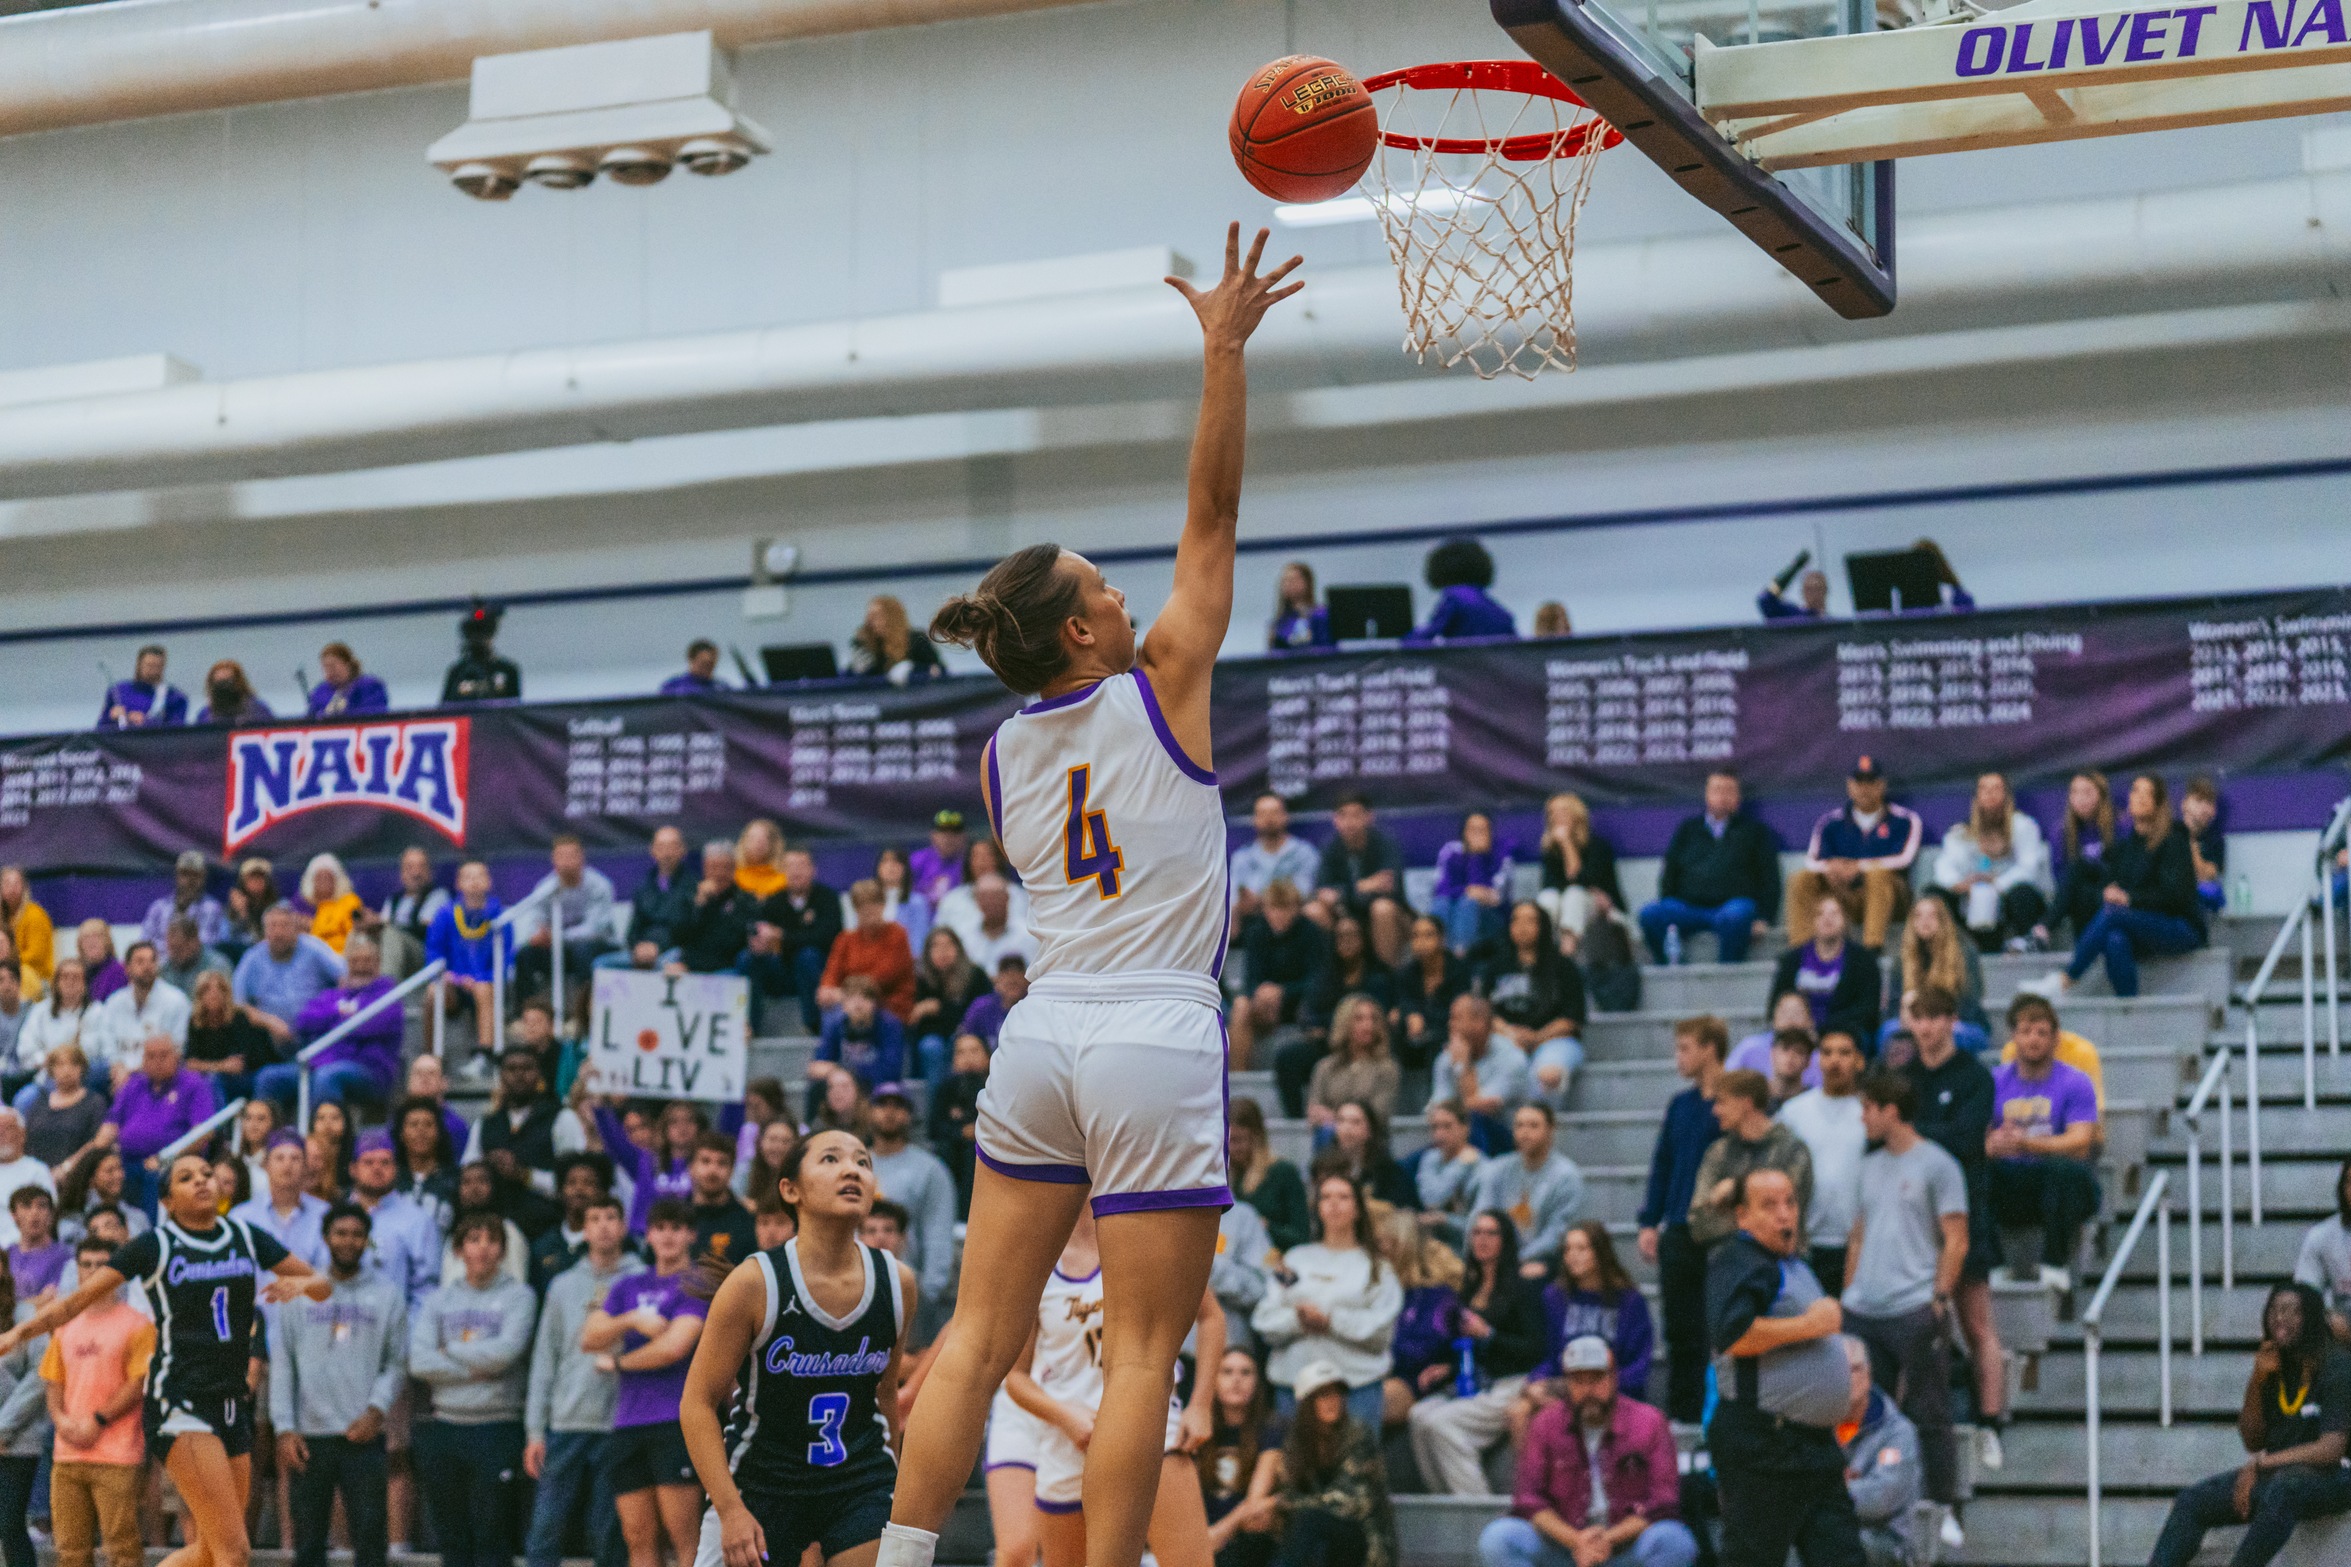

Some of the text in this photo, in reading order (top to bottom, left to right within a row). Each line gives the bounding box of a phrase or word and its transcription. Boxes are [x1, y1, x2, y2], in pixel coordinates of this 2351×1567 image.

[1955, 0, 2351, 77] OLIVET NA
[230, 726, 461, 840] NAIA
[1063, 762, 1126, 901] 4
[661, 975, 680, 1006] I
[633, 1056, 702, 1092] LIV
[168, 1248, 253, 1286] Crusade
[210, 1286, 231, 1342] 1
[808, 1392, 850, 1467] 3
